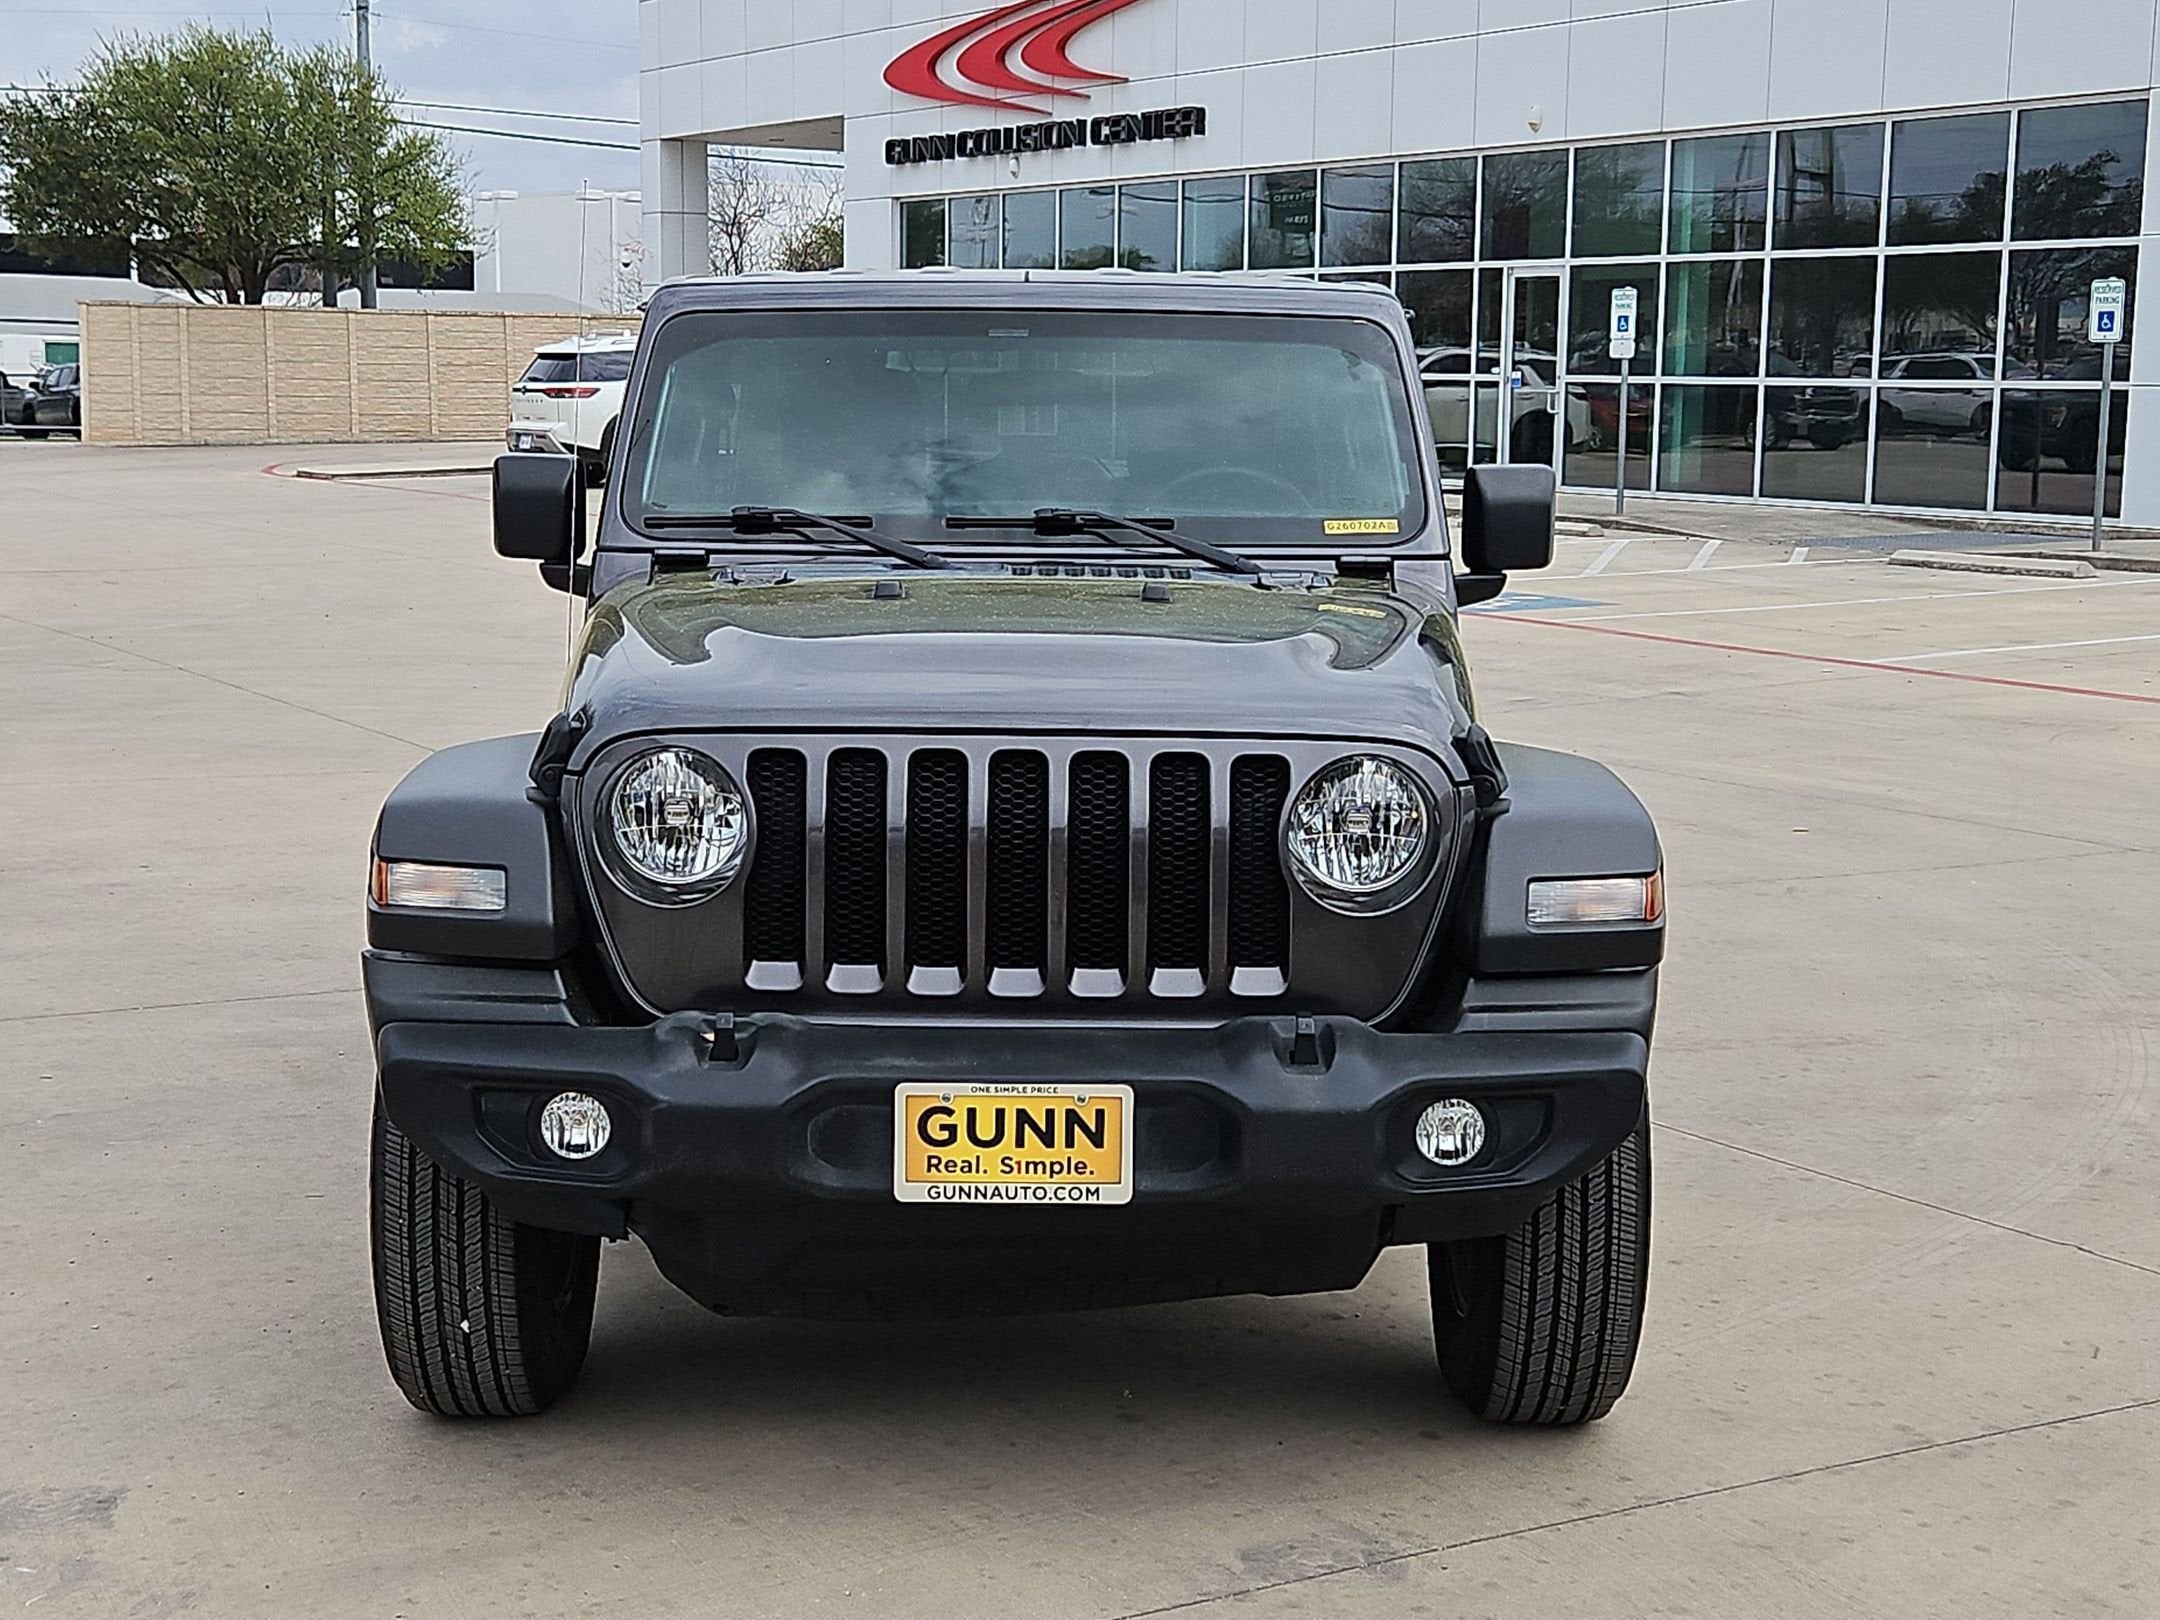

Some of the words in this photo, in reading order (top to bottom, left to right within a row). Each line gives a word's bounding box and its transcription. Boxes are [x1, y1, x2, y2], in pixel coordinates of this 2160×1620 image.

[885, 134, 956, 165] GUNN
[957, 119, 1087, 158] COLLISION
[1090, 106, 1206, 145] CENTER
[994, 1086, 1028, 1094] SIMPLE
[1030, 1086, 1059, 1094] PRICE
[917, 1106, 1105, 1148] GUNN
[926, 1154, 988, 1174] Real.
[927, 1185, 1100, 1201] GUNNAUTO.COM
